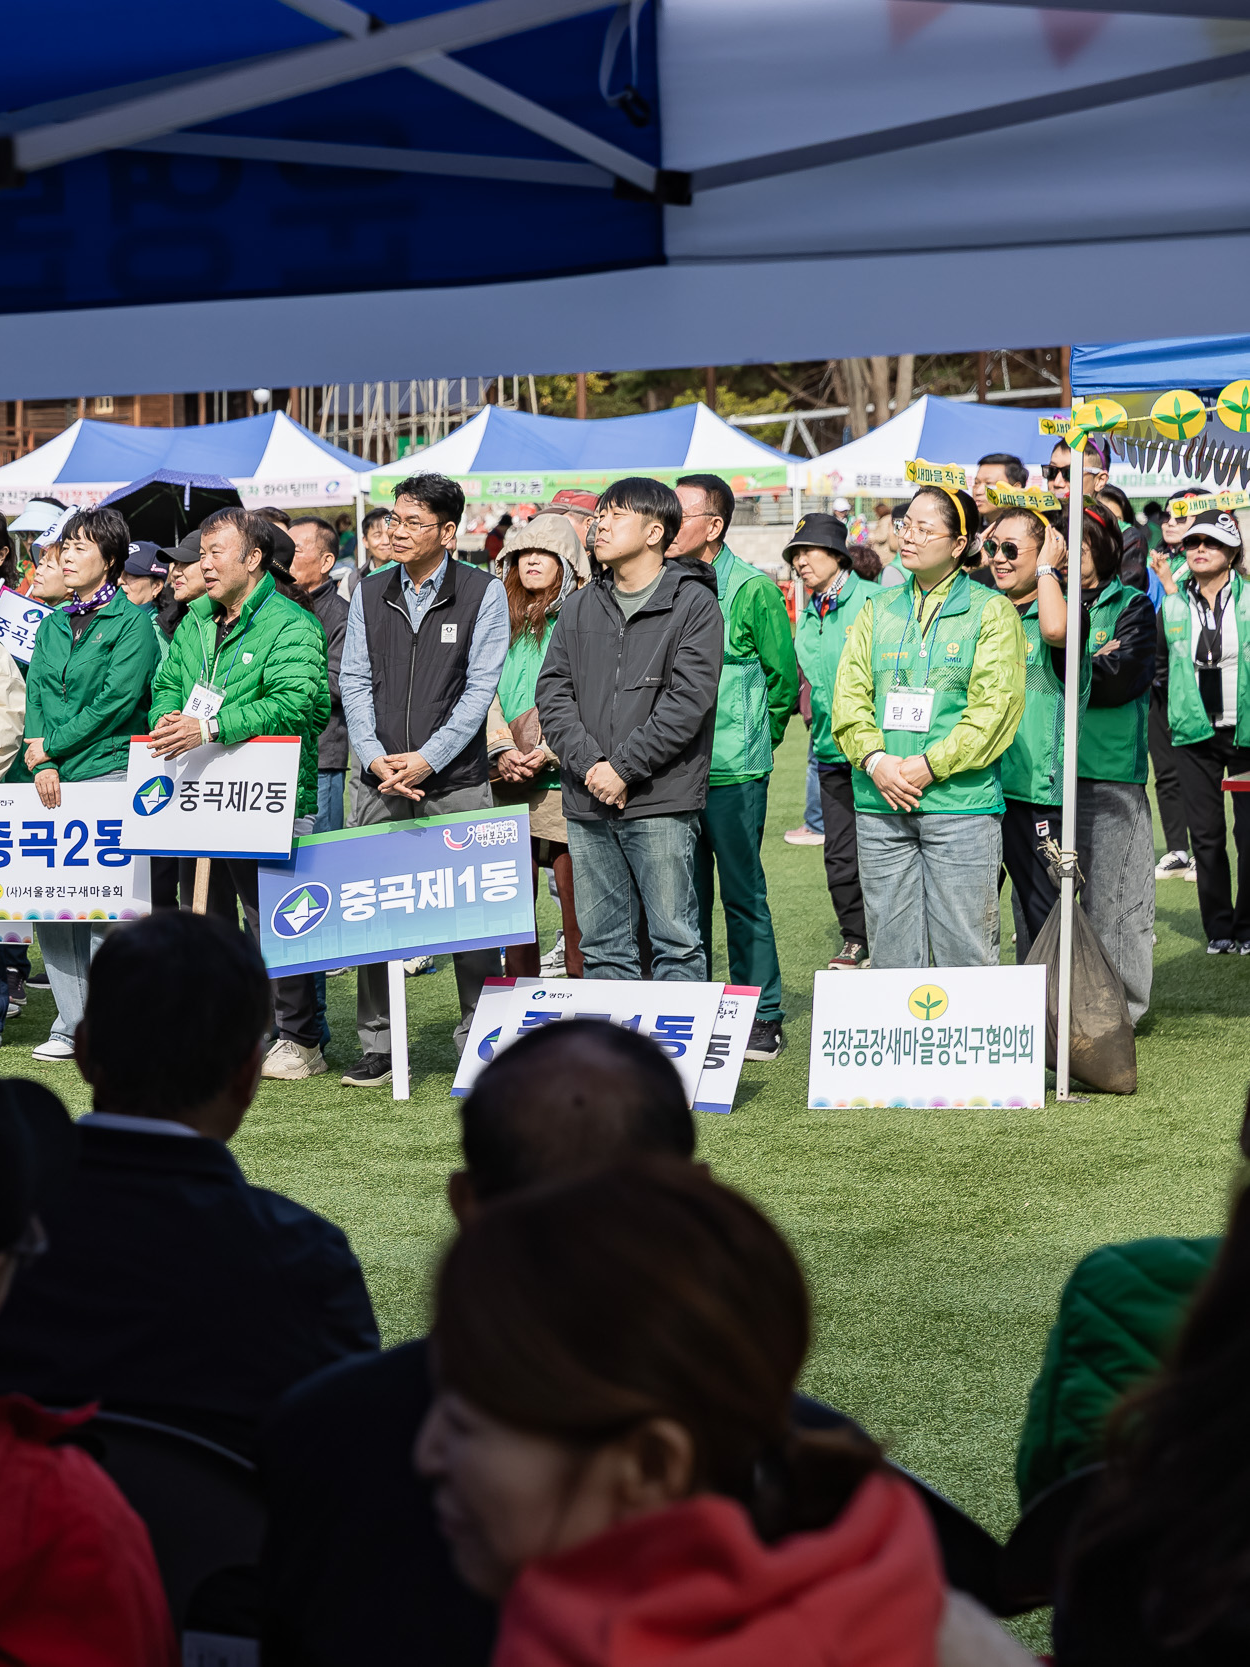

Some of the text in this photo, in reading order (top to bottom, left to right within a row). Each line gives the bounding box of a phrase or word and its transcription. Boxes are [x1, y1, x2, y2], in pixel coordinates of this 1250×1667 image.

[916, 466, 942, 483] 새마을
[999, 492, 1026, 507] 새마을
[1189, 498, 1217, 511] 새마을
[179, 780, 288, 814] 중곡제2동
[477, 829, 516, 846] 행복광진
[6, 885, 124, 899] (사)서울광진구새마을회
[339, 859, 520, 922] 중곡제1동
[822, 1024, 1035, 1067] 직장공장새마을광진구협의회
